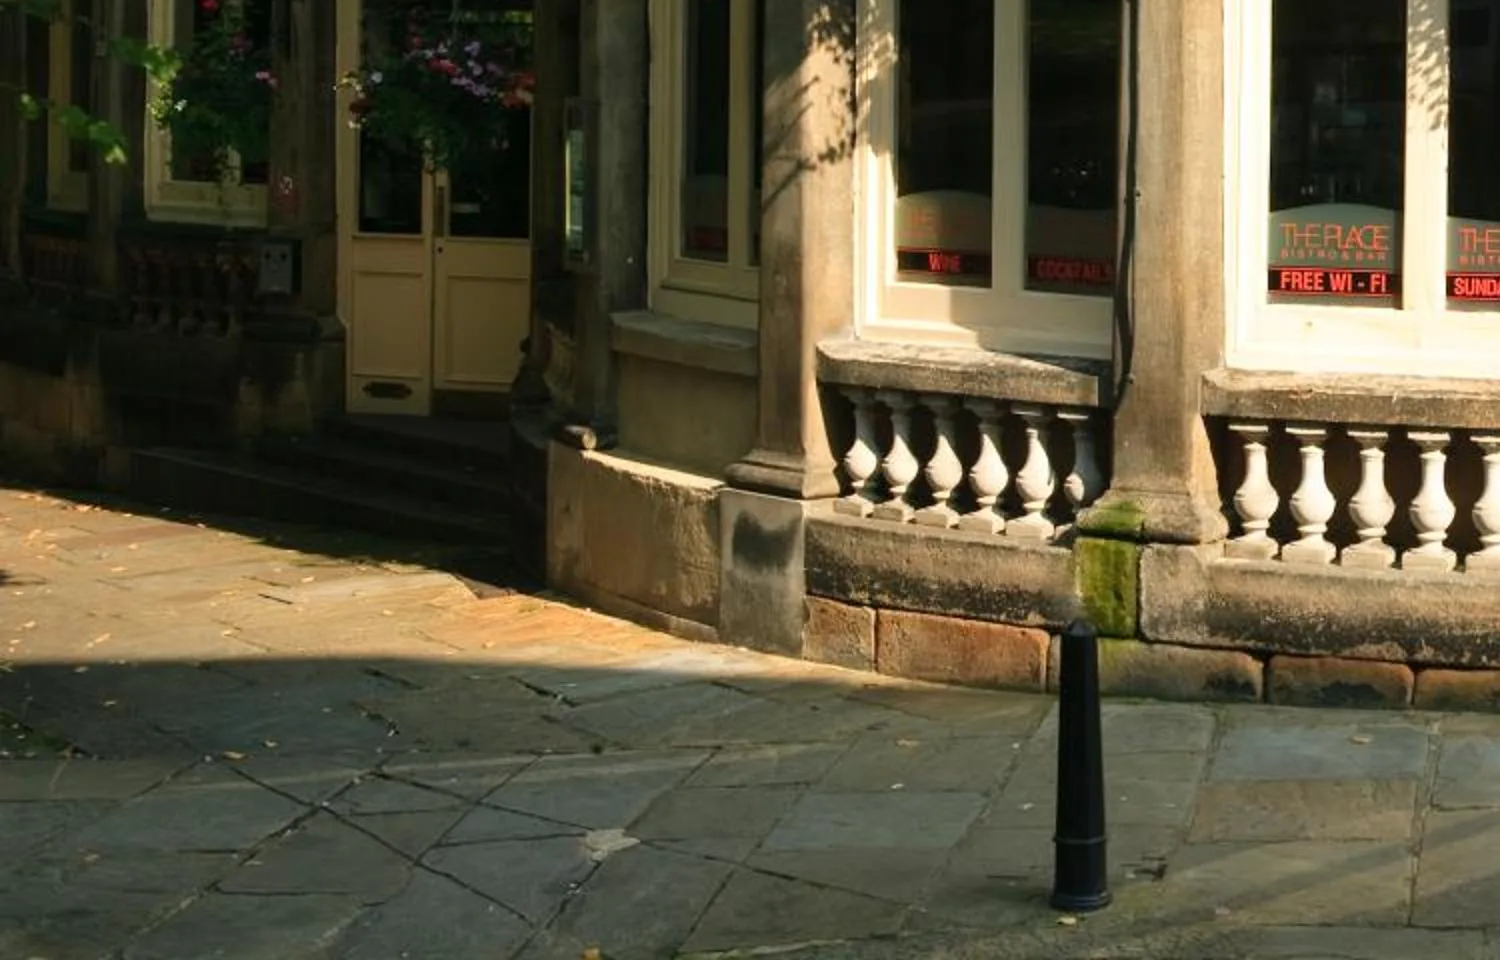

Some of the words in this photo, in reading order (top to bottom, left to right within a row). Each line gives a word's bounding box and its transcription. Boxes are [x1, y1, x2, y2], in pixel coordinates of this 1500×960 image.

[1280, 223, 1320, 248] THE
[1323, 224, 1391, 251] PLACE
[1280, 271, 1325, 291] FREE
[1329, 272, 1353, 294] WI
[1370, 274, 1387, 294] FI
